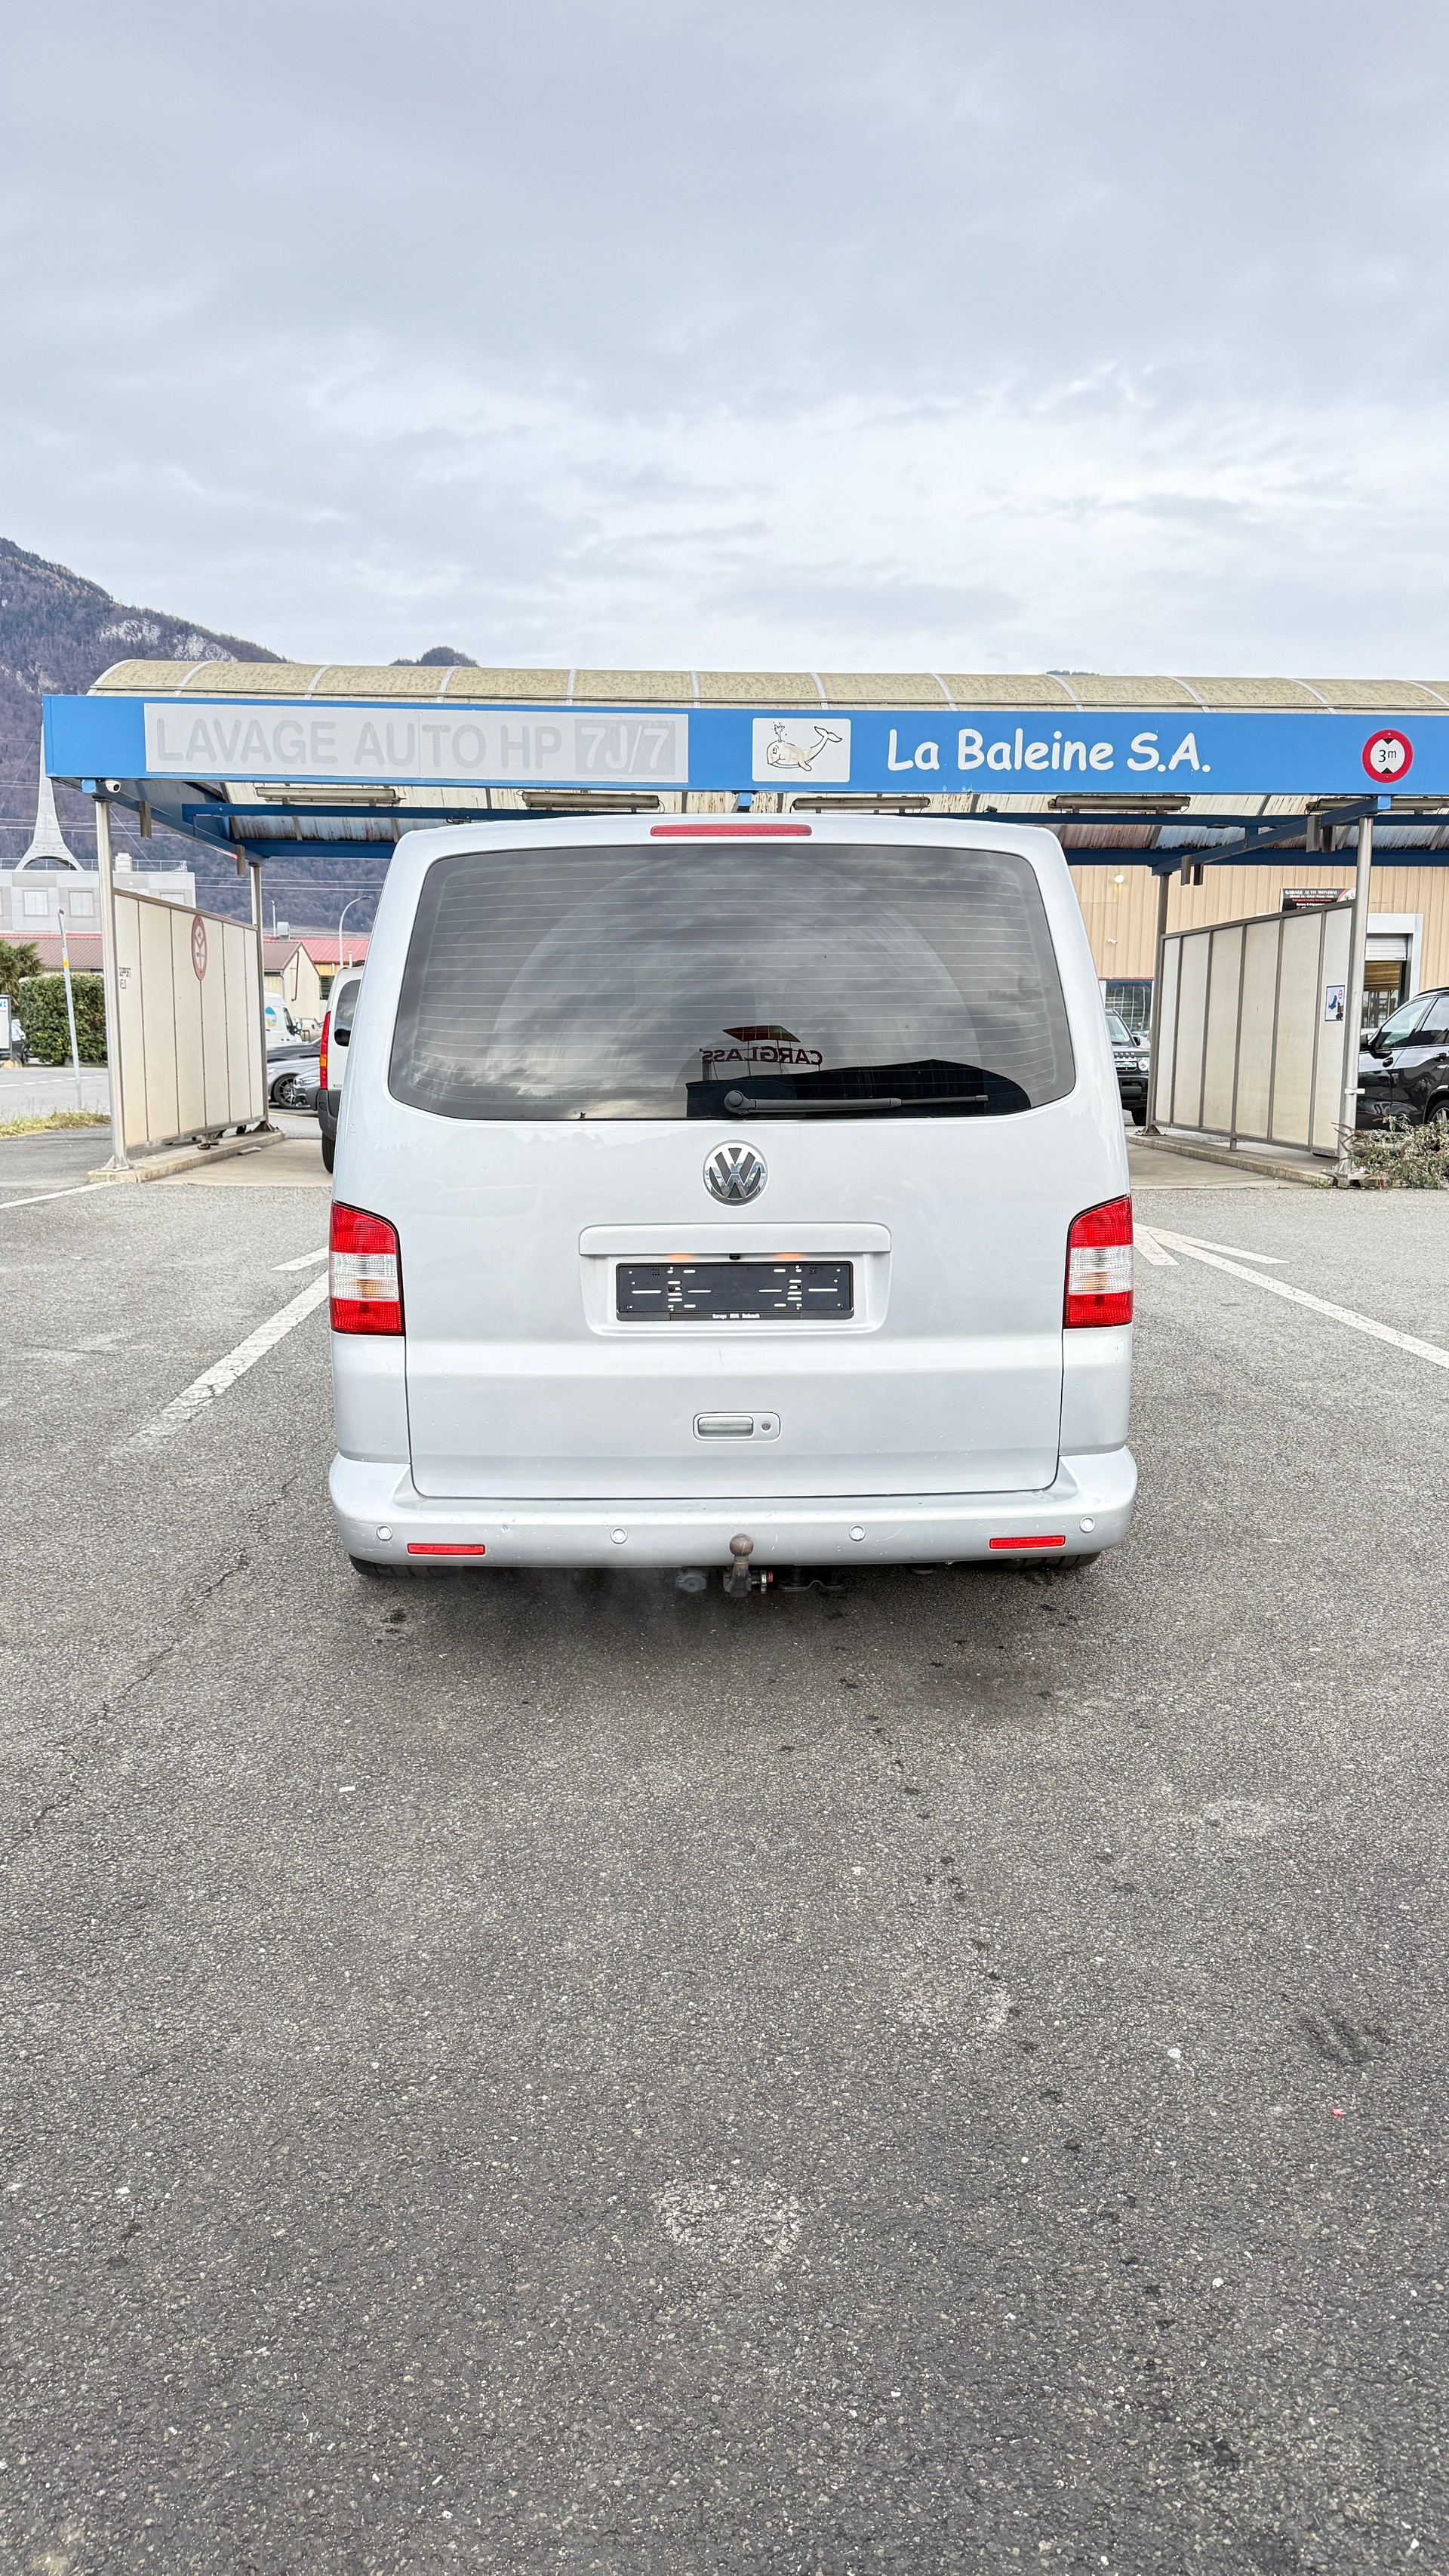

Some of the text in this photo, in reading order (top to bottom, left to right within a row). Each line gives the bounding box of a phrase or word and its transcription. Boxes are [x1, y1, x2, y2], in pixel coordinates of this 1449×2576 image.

[156, 717, 669, 774] LAVAGE AUTO HP 7J/7
[887, 728, 1211, 773] La Baleine S.A.
